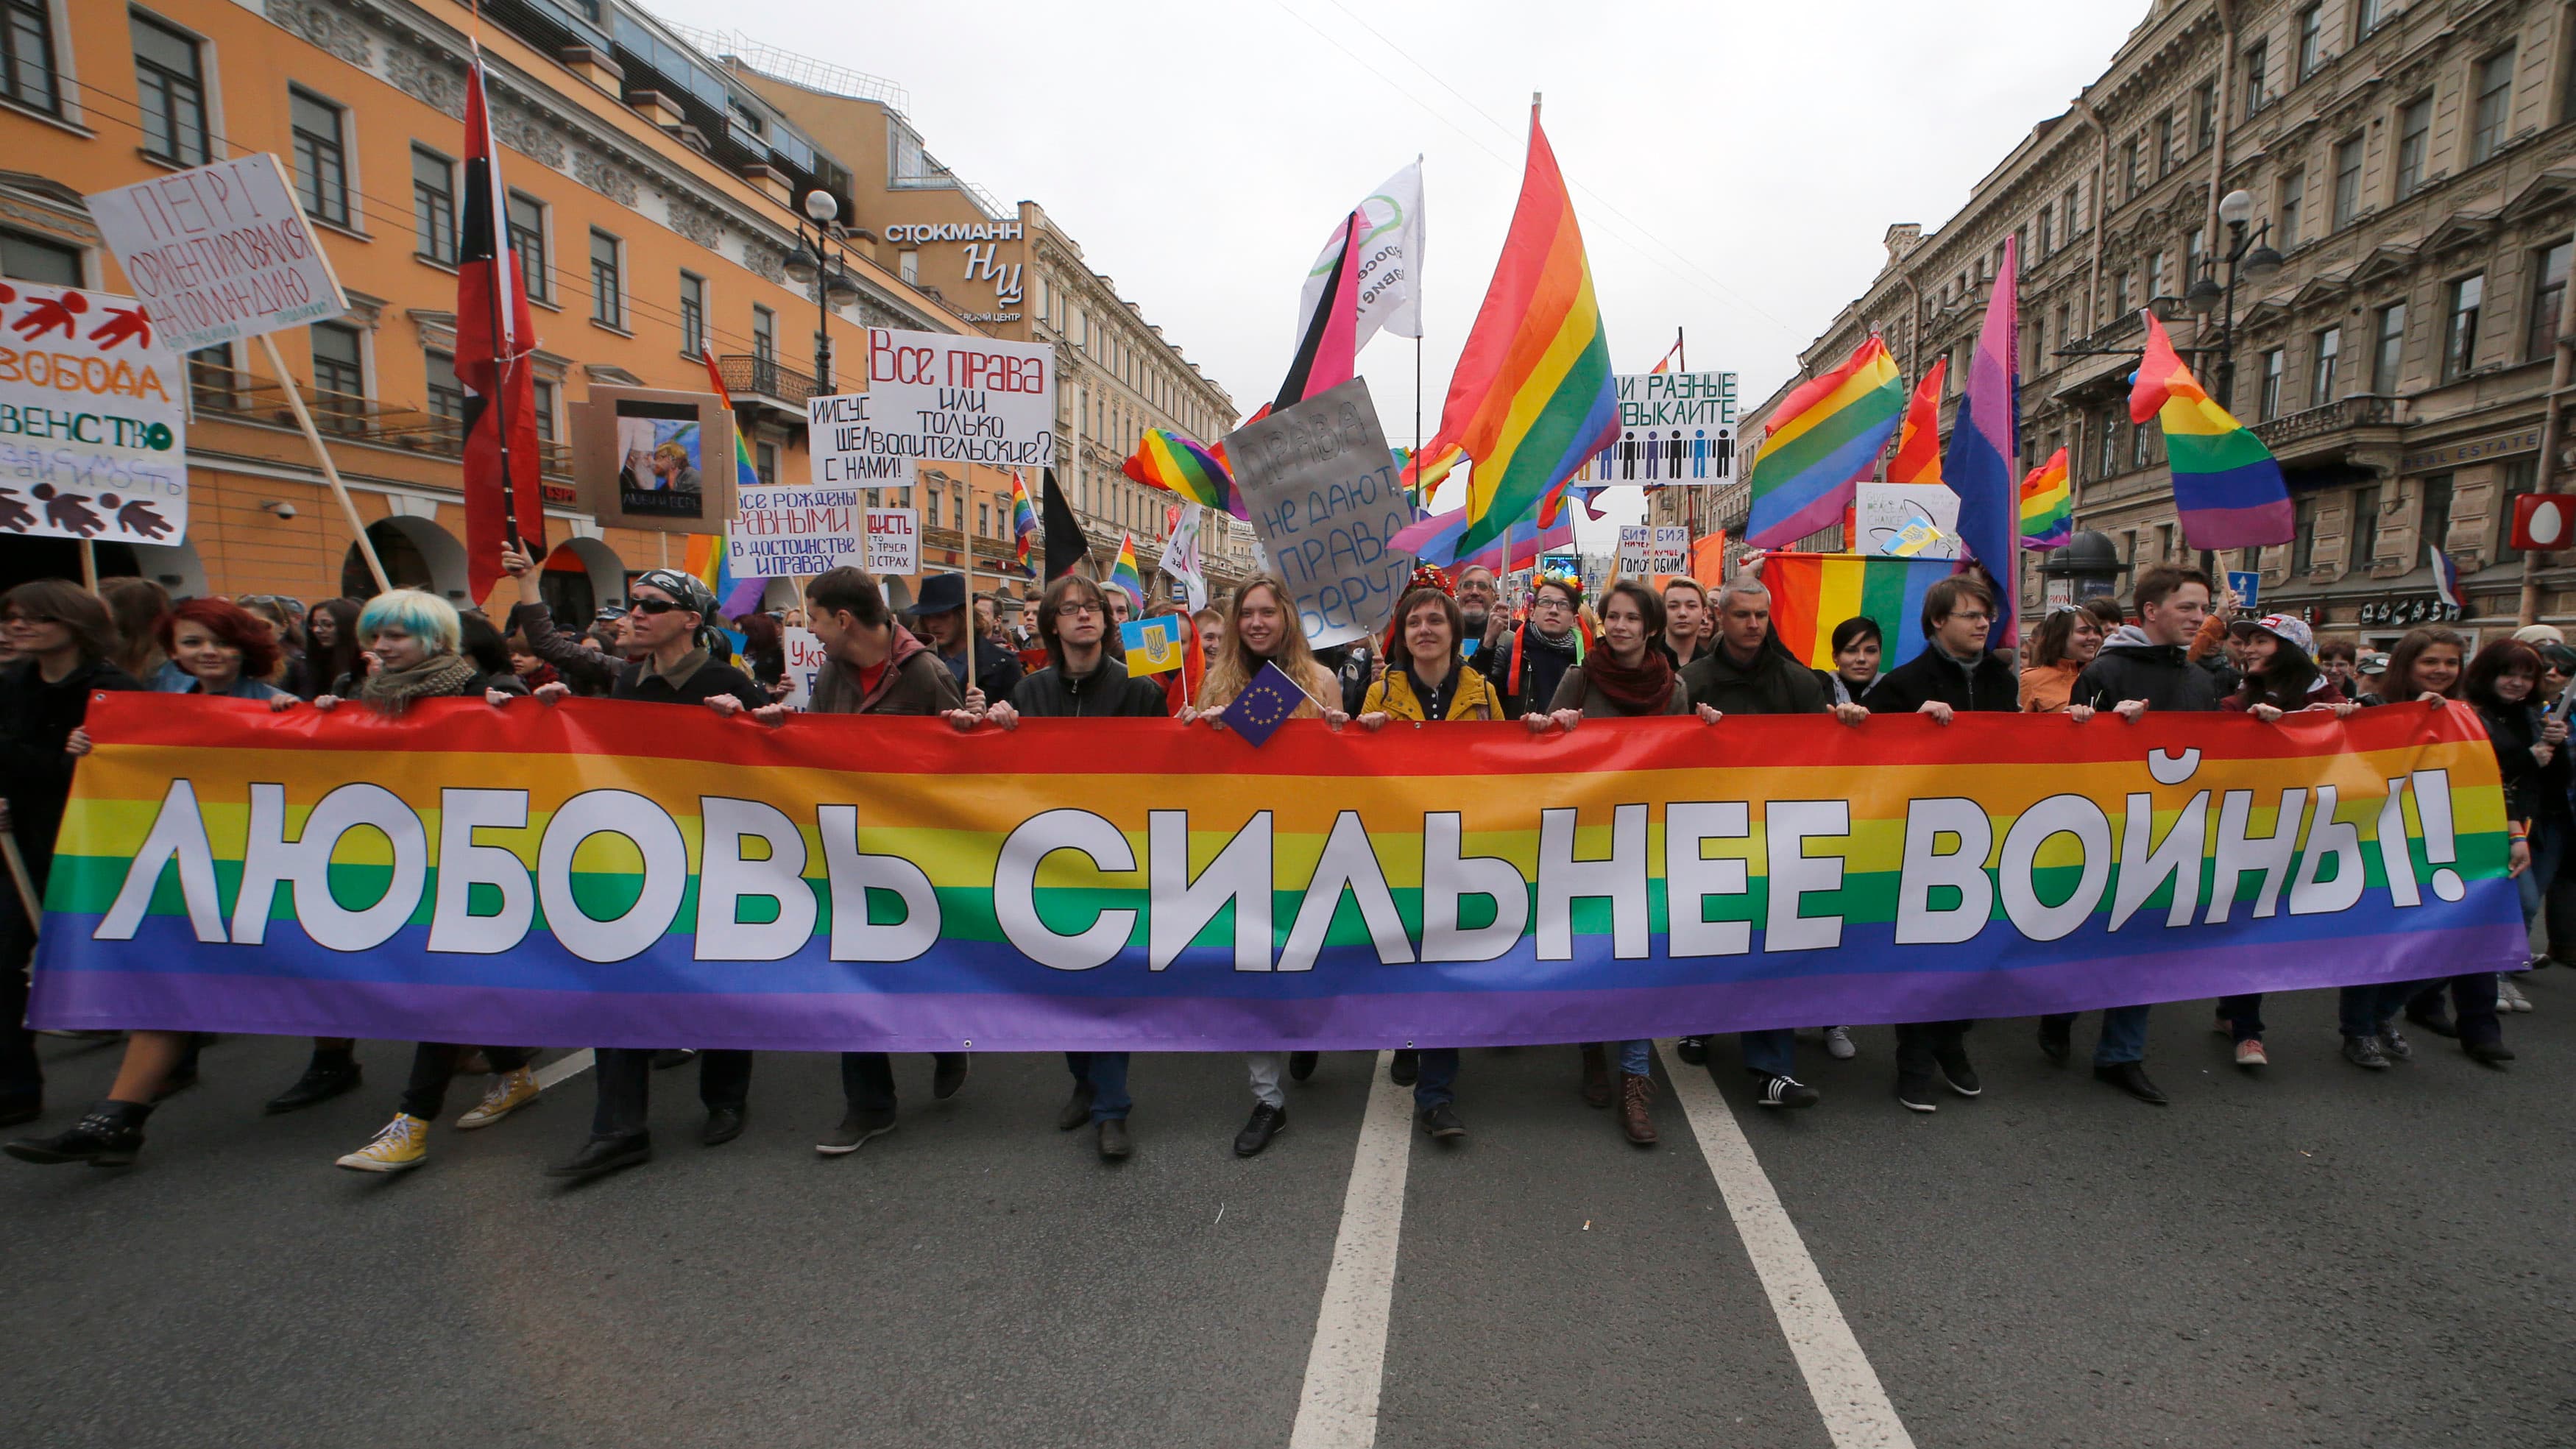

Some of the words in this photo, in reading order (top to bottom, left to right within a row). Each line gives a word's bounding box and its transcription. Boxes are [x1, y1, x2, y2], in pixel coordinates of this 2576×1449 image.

[885, 223, 1023, 242] СТОКМАНН
[994, 313, 1021, 322] ЦЕНТР
[1648, 373, 1736, 400] РАЗНЫЕ
[813, 397, 870, 424] ИИСУС
[0, 404, 173, 451] ВЕНСТВО
[2458, 433, 2538, 460] ESTATE
[846, 456, 902, 481] НАМИ!
[1867, 503, 1895, 513] PEACE
[1867, 516, 1903, 526] CHANCE
[1278, 512, 1403, 585] ПРАВА
[1622, 529, 1684, 542] БИФБИЯ
[92, 778, 942, 963] ЛЮБОВЬ
[993, 800, 1850, 972] СИЛЬНЕЕ
[1894, 747, 2466, 944] ВОЙНЫ!
